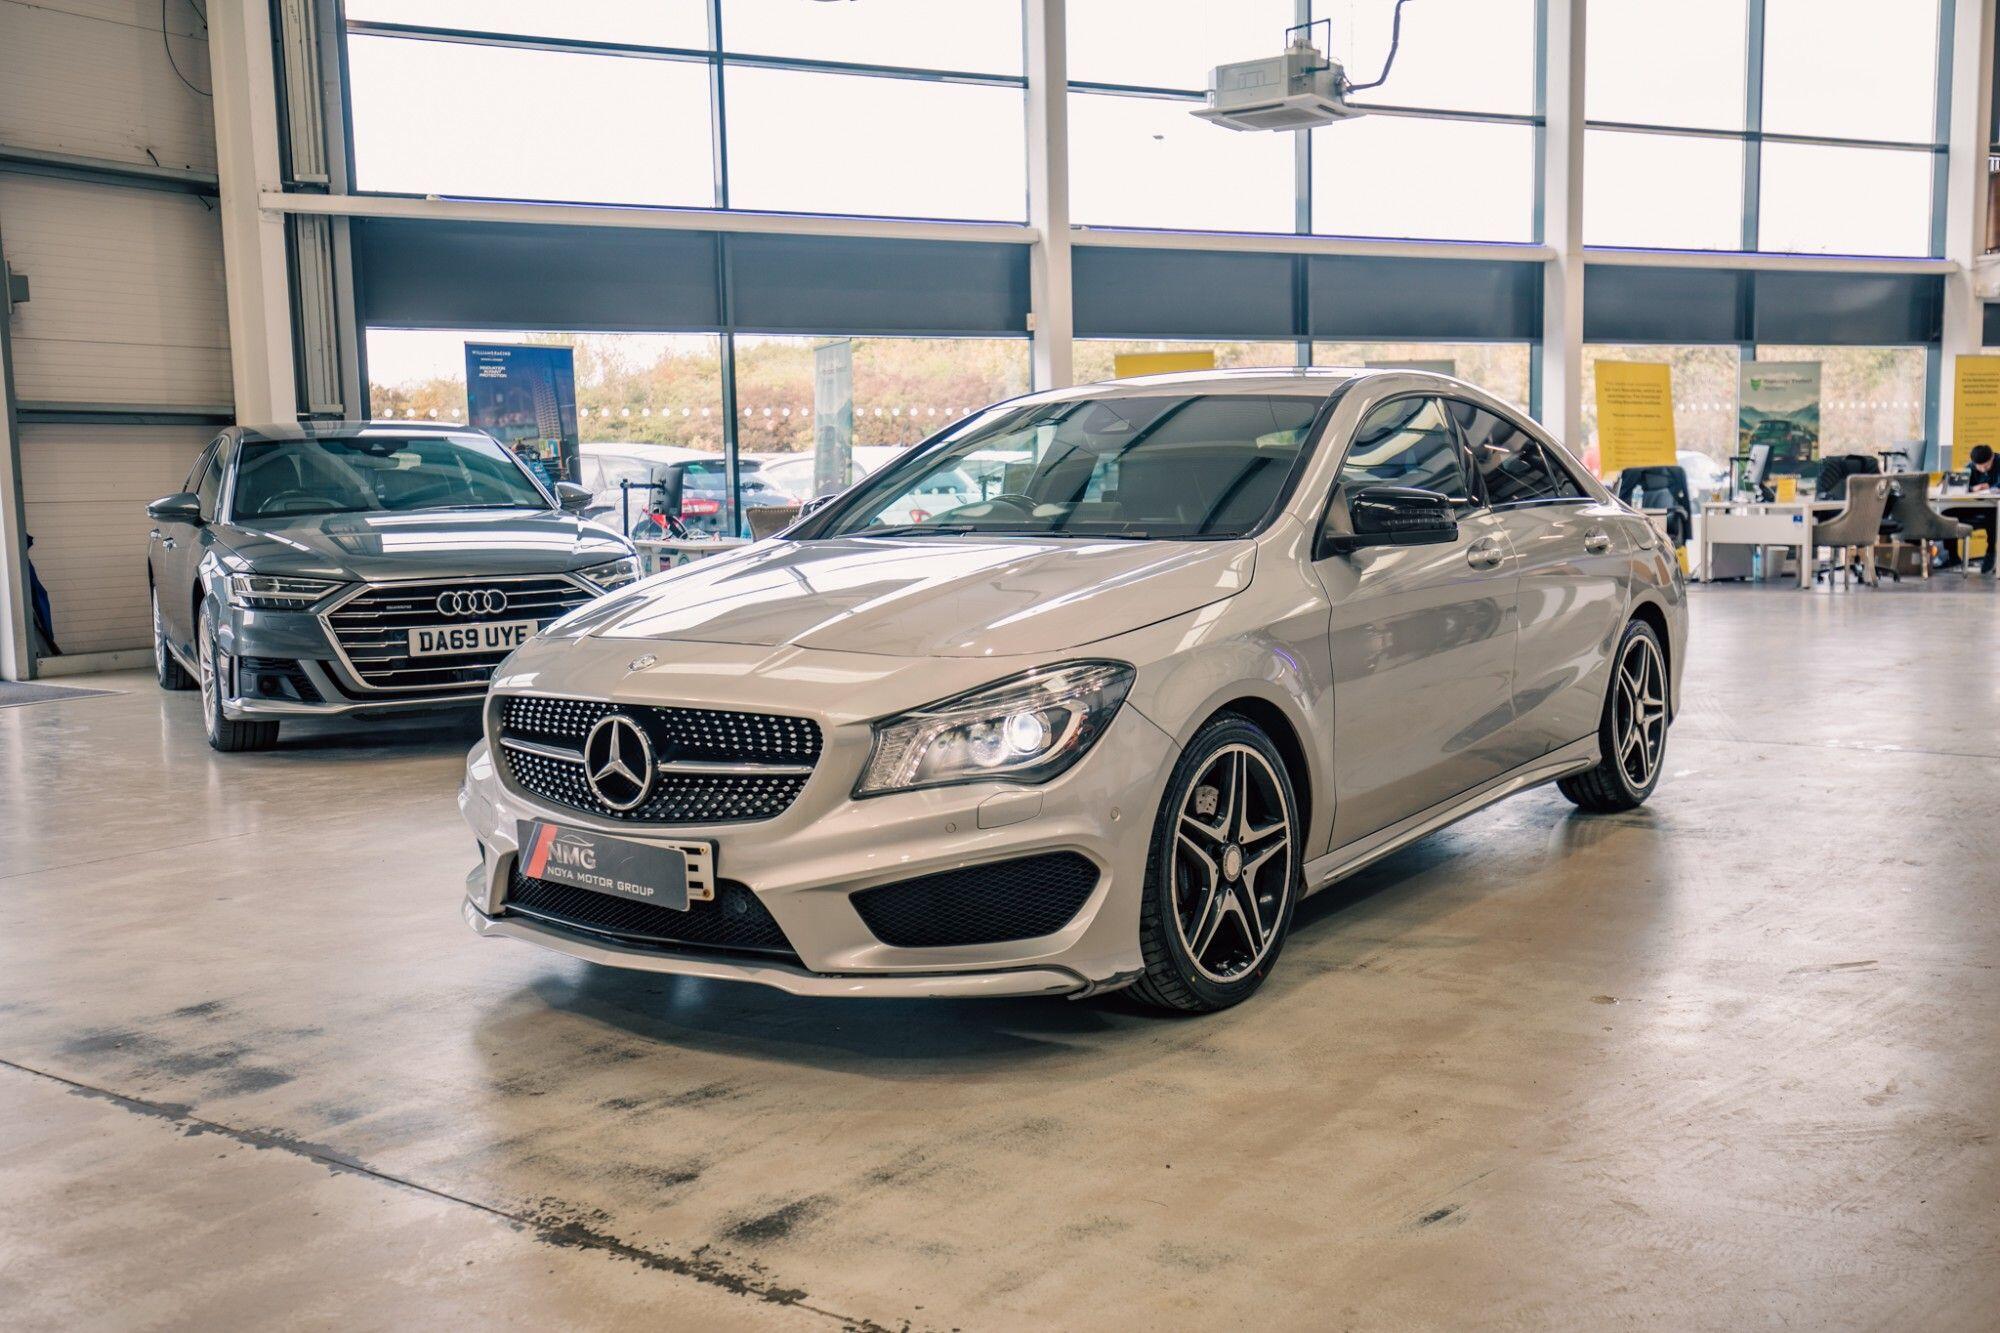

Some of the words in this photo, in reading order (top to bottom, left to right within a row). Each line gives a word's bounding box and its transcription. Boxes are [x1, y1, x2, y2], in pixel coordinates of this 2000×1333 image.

[419, 628, 479, 653] DA69
[485, 624, 528, 648] UYE
[547, 841, 597, 870] NMG
[547, 866, 574, 881] NOYA
[576, 871, 614, 889] MOTOR
[616, 880, 655, 898] GROUP
